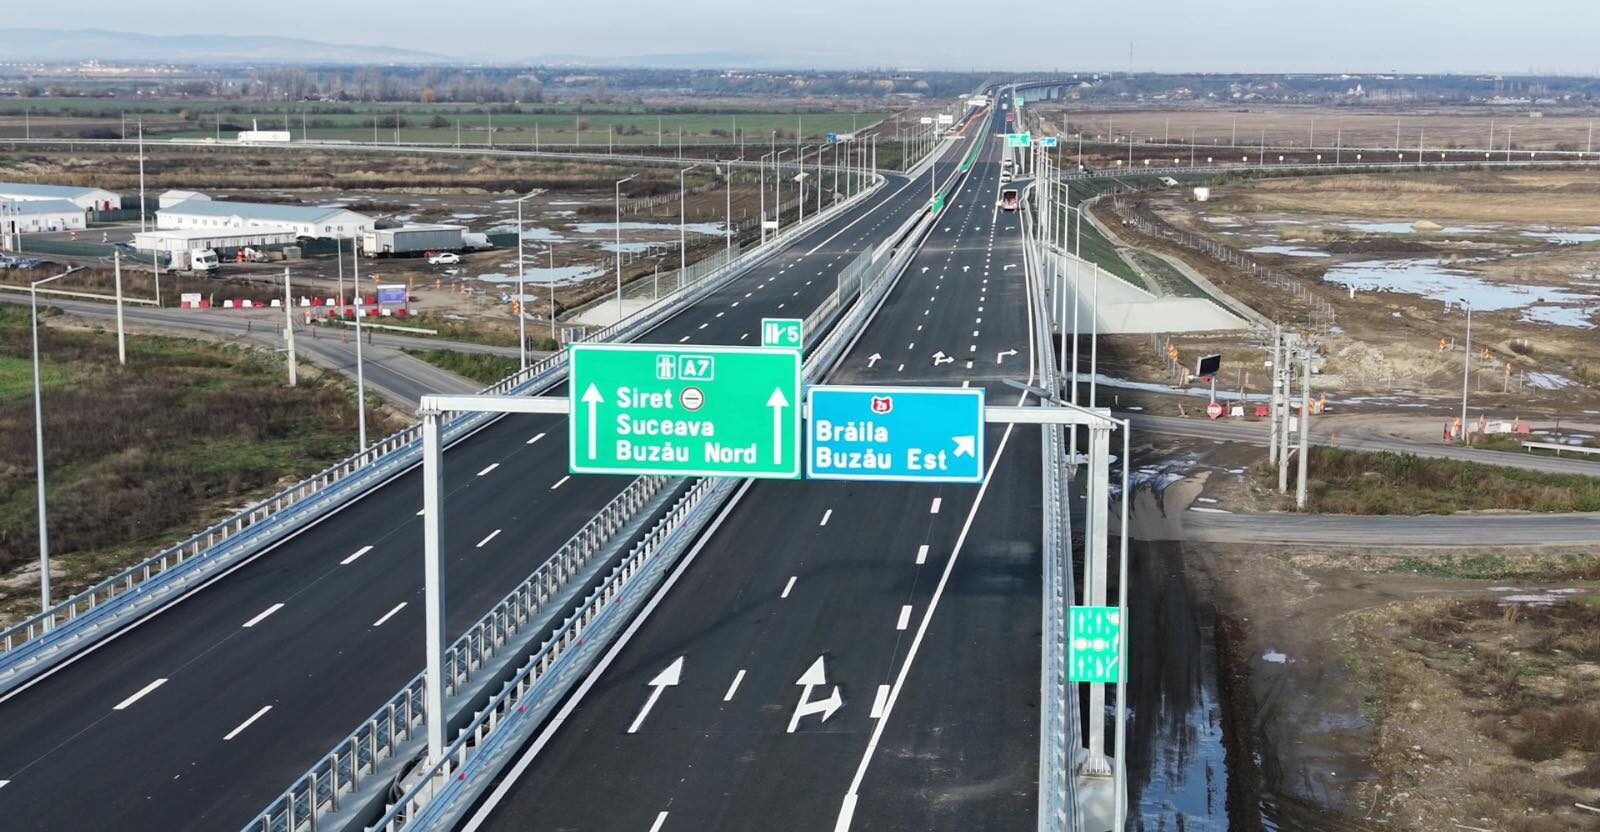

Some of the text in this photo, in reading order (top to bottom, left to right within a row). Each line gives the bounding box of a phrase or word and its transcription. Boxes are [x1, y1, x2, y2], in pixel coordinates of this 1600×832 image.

[787, 328, 799, 342] 5
[683, 359, 710, 377] A7
[616, 386, 673, 408] Siret
[616, 413, 714, 436] Suceava
[816, 419, 889, 442] Brăila
[616, 439, 757, 464] Buzău Nord
[816, 446, 948, 470] Buzău Est
